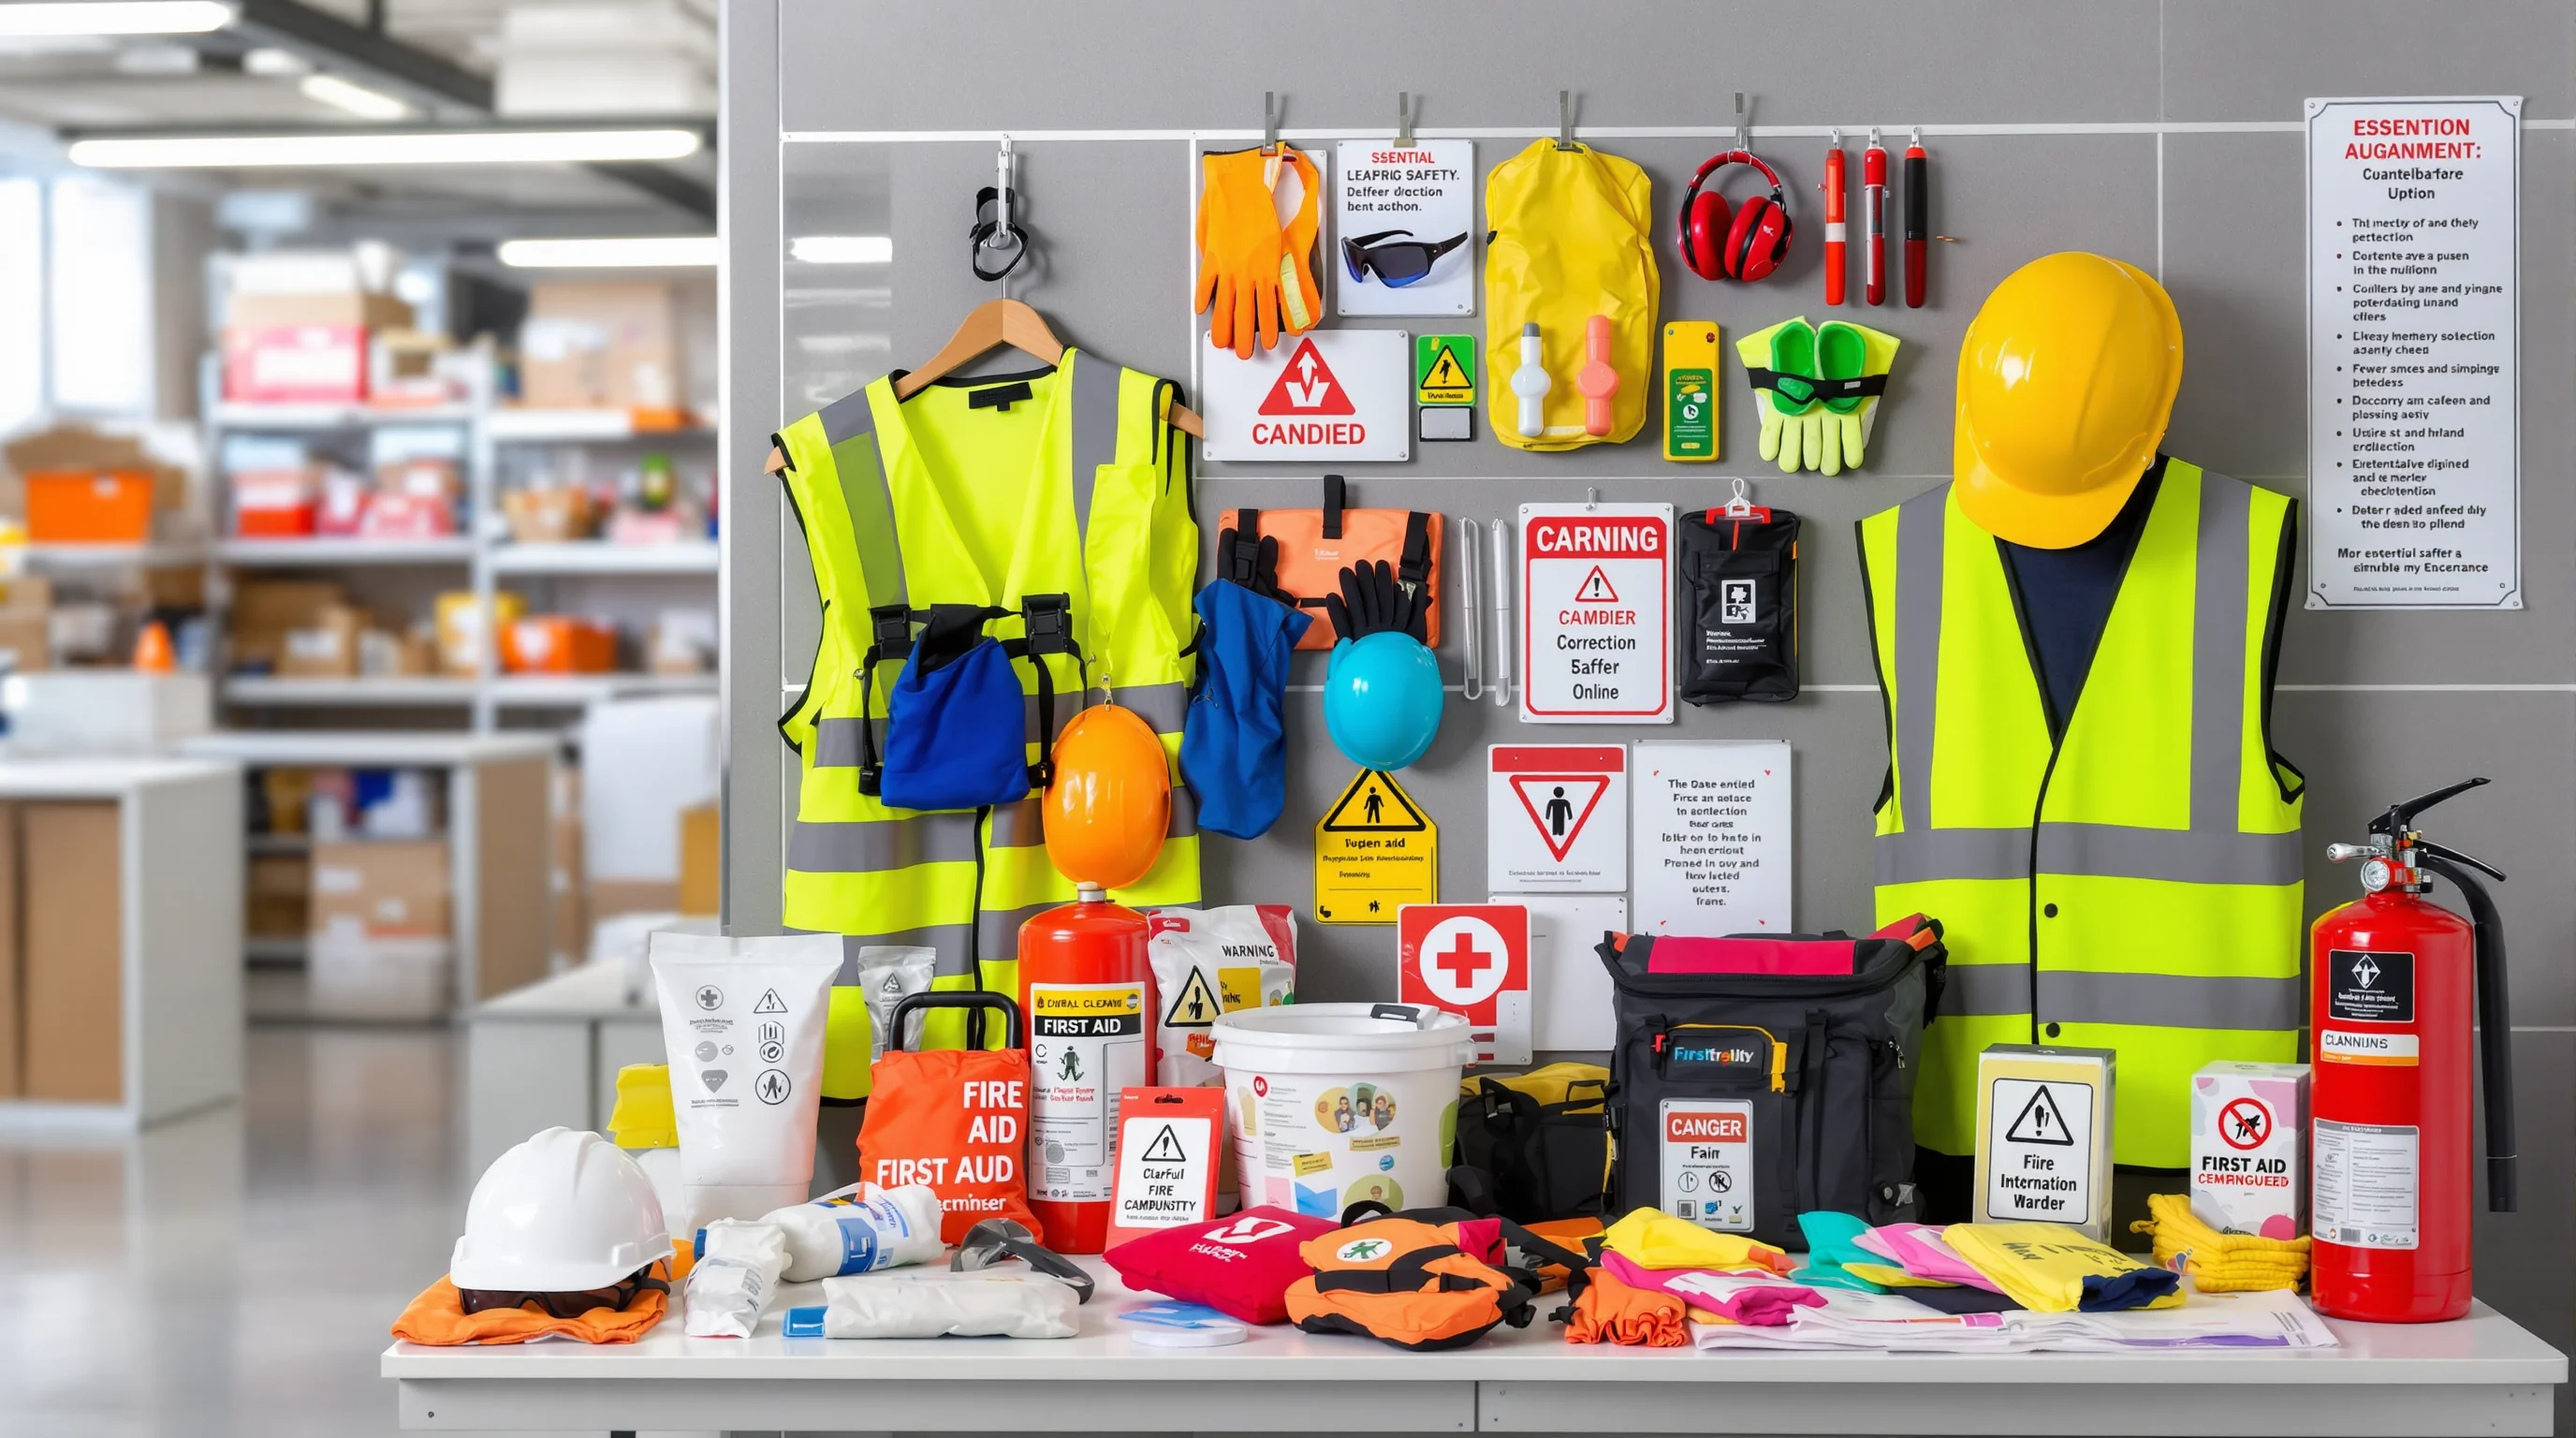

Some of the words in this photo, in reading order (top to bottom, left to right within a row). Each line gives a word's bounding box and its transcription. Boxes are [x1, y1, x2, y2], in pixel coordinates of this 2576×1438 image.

[2353, 119, 2471, 137] ESSENTION
[1371, 152, 1435, 164] SSENTIAL
[2345, 141, 2481, 159] AUGANMENT:
[2387, 187, 2436, 201] Uption
[2441, 284, 2462, 294] and
[2427, 363, 2448, 374] and
[2468, 395, 2491, 405] and
[1251, 423, 1366, 446] CANDIED
[1536, 526, 1659, 553] CARNING
[1556, 634, 1636, 651] Correction
[1572, 683, 1619, 700] Online
[1044, 1020, 1089, 1034] FIRST
[1091, 1019, 1121, 1034] AID
[962, 1080, 1024, 1109] FIRE
[967, 1116, 1017, 1144] AID
[1671, 1118, 1742, 1137] CANGER
[876, 1158, 949, 1187] FIRST
[954, 1155, 1014, 1184] AUD
[2202, 1156, 2251, 1172] FIRST
[2255, 1158, 2287, 1174] AID
[1149, 1185, 1174, 1196] FIRE
[2013, 1194, 2065, 1211] Warder
